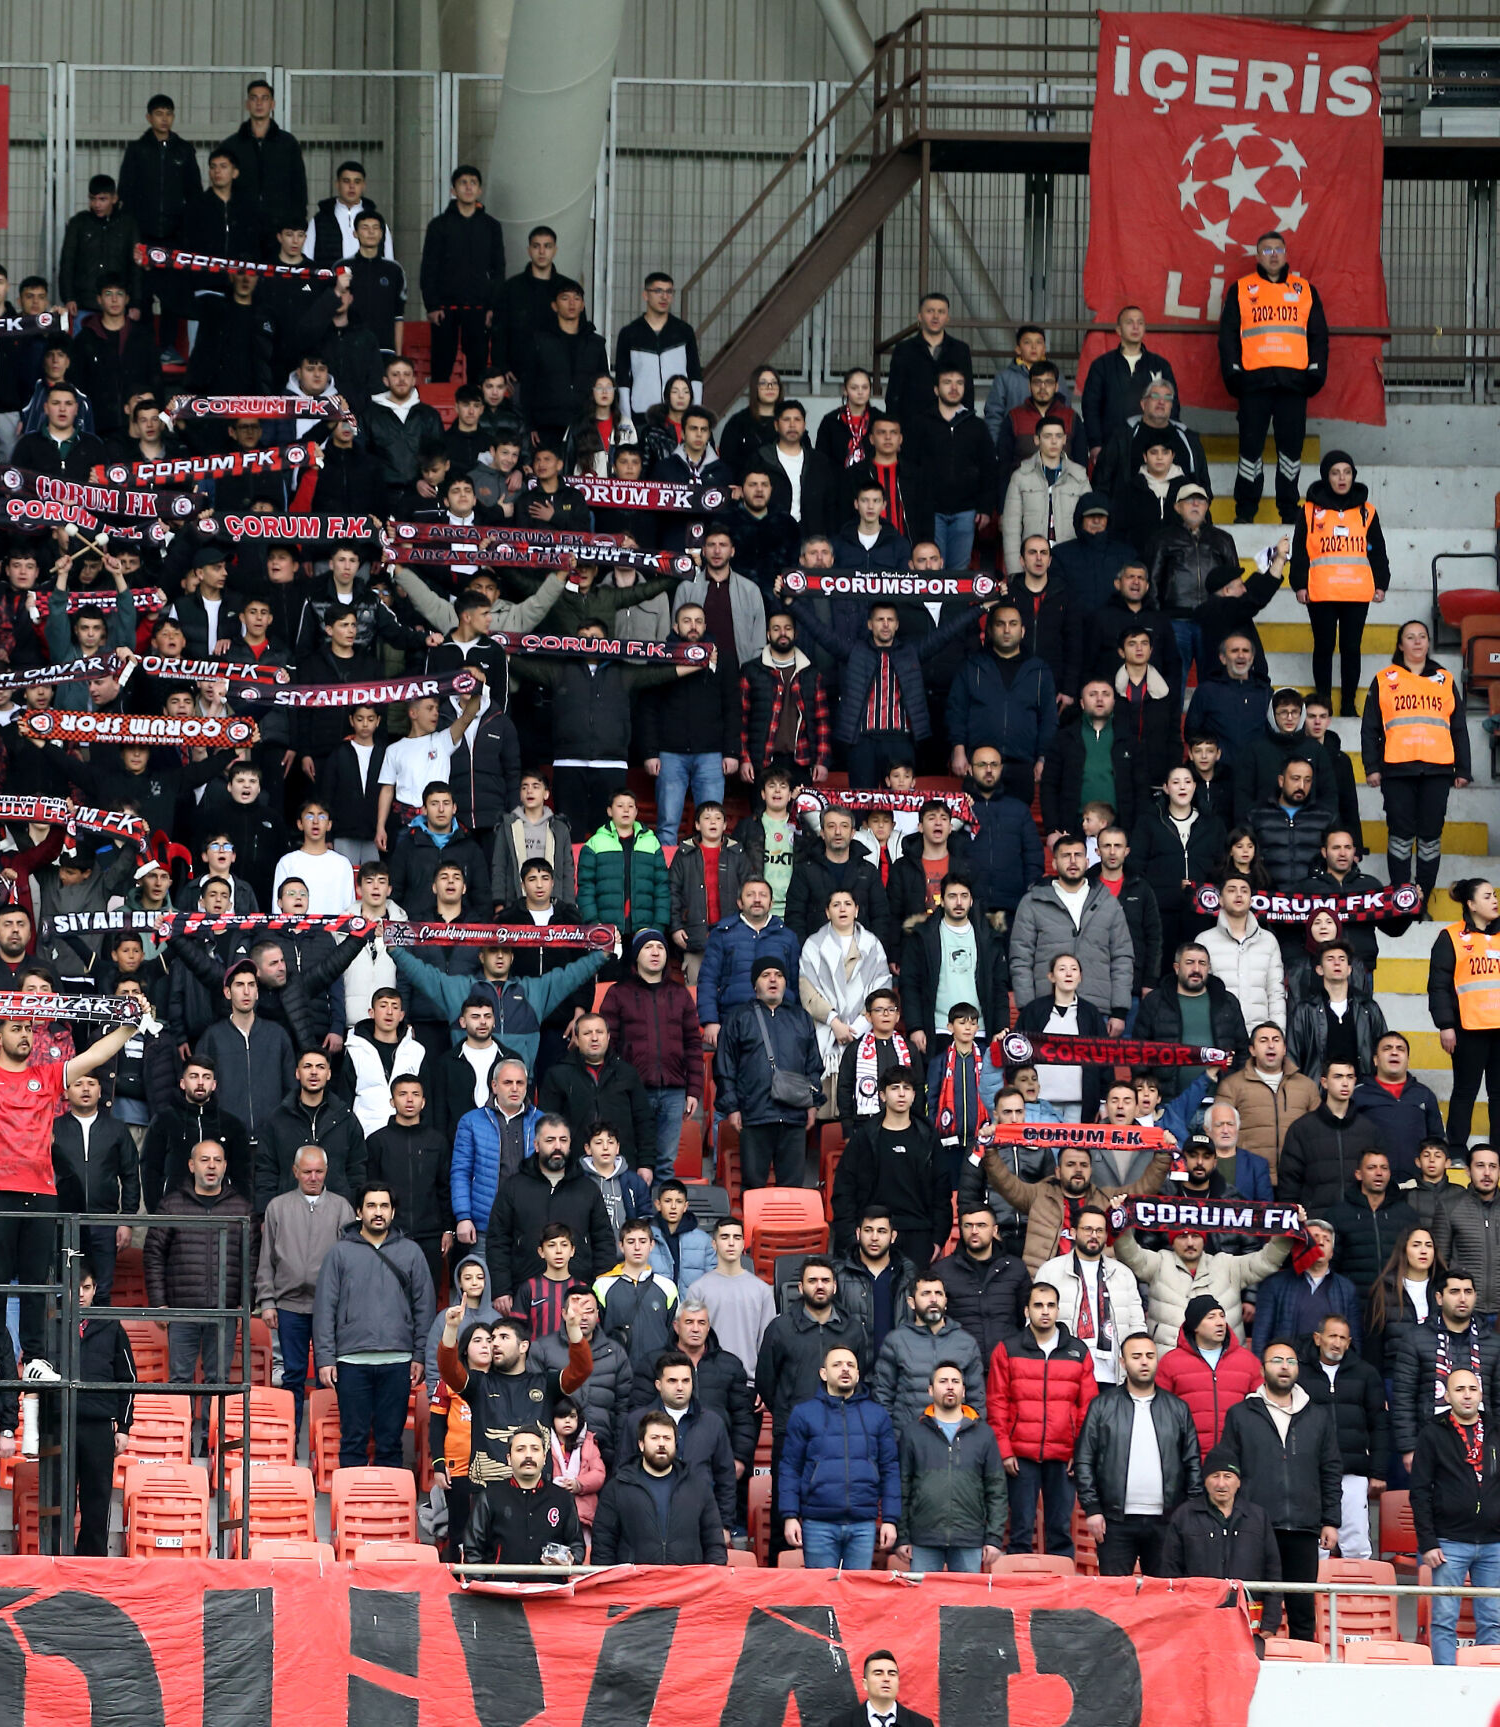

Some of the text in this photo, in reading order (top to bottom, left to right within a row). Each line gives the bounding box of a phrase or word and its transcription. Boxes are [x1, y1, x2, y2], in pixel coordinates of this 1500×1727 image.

[1113, 36, 1373, 116] İÇERİS
[190, 399, 329, 417] ÇORUM FK
[137, 450, 274, 480] ÇORUM FK
[36, 475, 158, 518] ÇORUM FK
[658, 486, 694, 510] FK
[6, 498, 98, 531] ÇORUM
[223, 513, 373, 542] ÇORUM F.K.
[428, 526, 585, 547] ARCA FK
[408, 548, 460, 562] ARCA
[537, 551, 563, 566] FK
[626, 552, 661, 568] FK
[820, 576, 958, 597] ÇORUMSPOR
[521, 634, 673, 659] ÇORUM F.K.
[22, 656, 106, 680] DUVAR
[225, 661, 260, 680] FK
[351, 680, 440, 704] DUVAR
[59, 714, 222, 738] ÇORUM SPOR
[103, 810, 143, 835] FK
[1250, 892, 1385, 912] ORUM FK
[54, 911, 124, 934] SİYAH
[0, 1008, 31, 1016] Duvar
[30, 991, 113, 1015] DUVAR
[1040, 1042, 1192, 1066] ÇORUMSPOR
[1135, 1201, 1302, 1230] ÇORUM FK
[547, 1507, 560, 1528] Ç
[157, 1538, 163, 1546] C
[171, 1538, 181, 1546] 12
